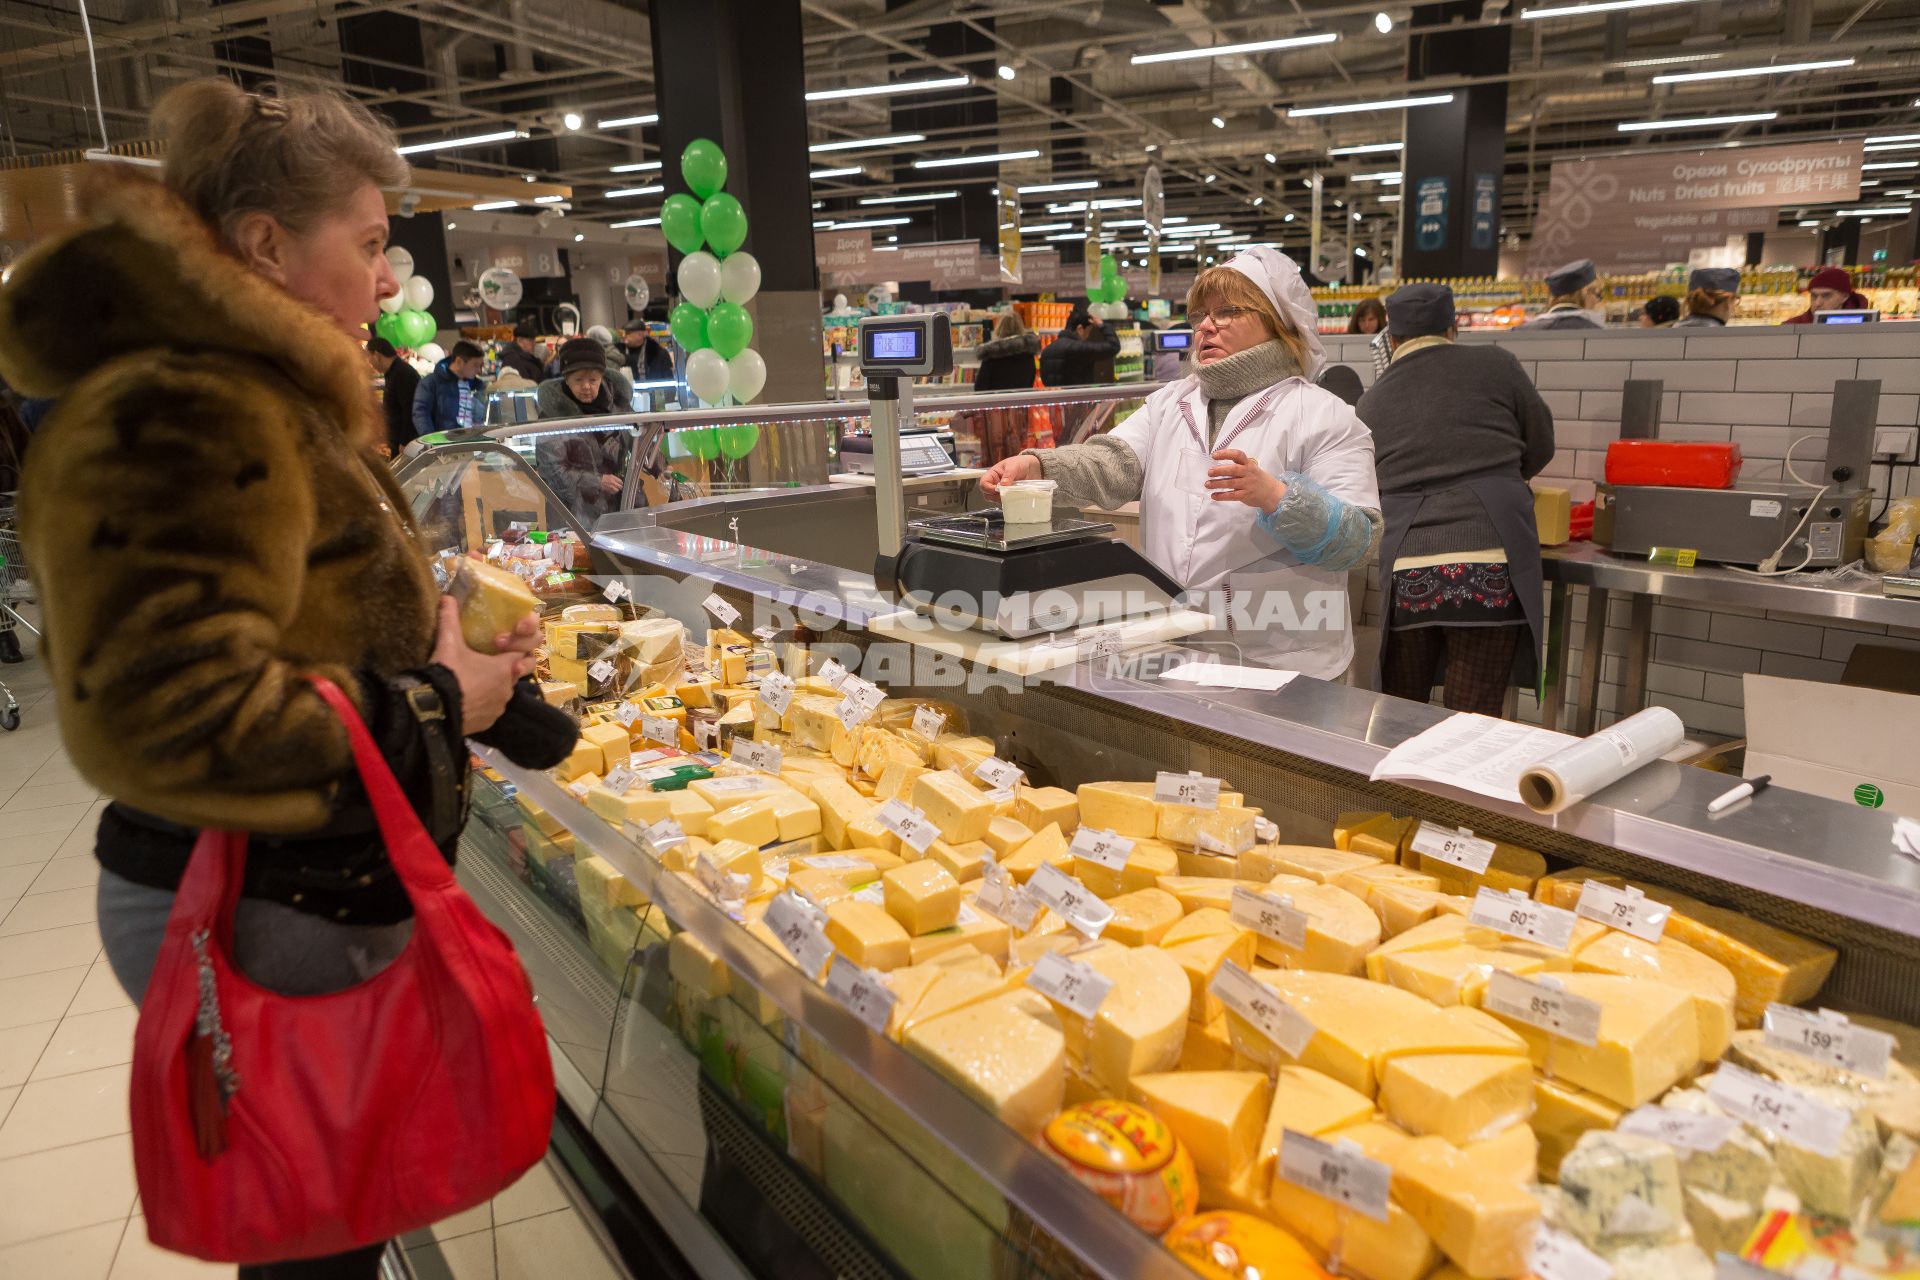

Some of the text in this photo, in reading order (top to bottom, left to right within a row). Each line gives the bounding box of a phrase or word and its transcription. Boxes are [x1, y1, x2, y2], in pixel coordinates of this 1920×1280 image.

[1736, 156, 1851, 177] Сухофрукты
[1629, 180, 1765, 202] Nuts Dried fruits
[1634, 211, 1717, 230] Vegetable oil
[538, 253, 550, 273] 8
[934, 256, 975, 269] Baby food
[610, 266, 621, 283] 9
[751, 751, 760, 761] 60
[1178, 785, 1190, 797] 51
[900, 818, 913, 830] 65
[1093, 841, 1105, 854] 29
[1443, 840, 1457, 853] 61
[1060, 890, 1075, 906] 79
[1509, 910, 1527, 925] 60
[1611, 901, 1627, 918] 79
[1530, 995, 1549, 1016] 85
[1801, 1027, 1832, 1049] 159
